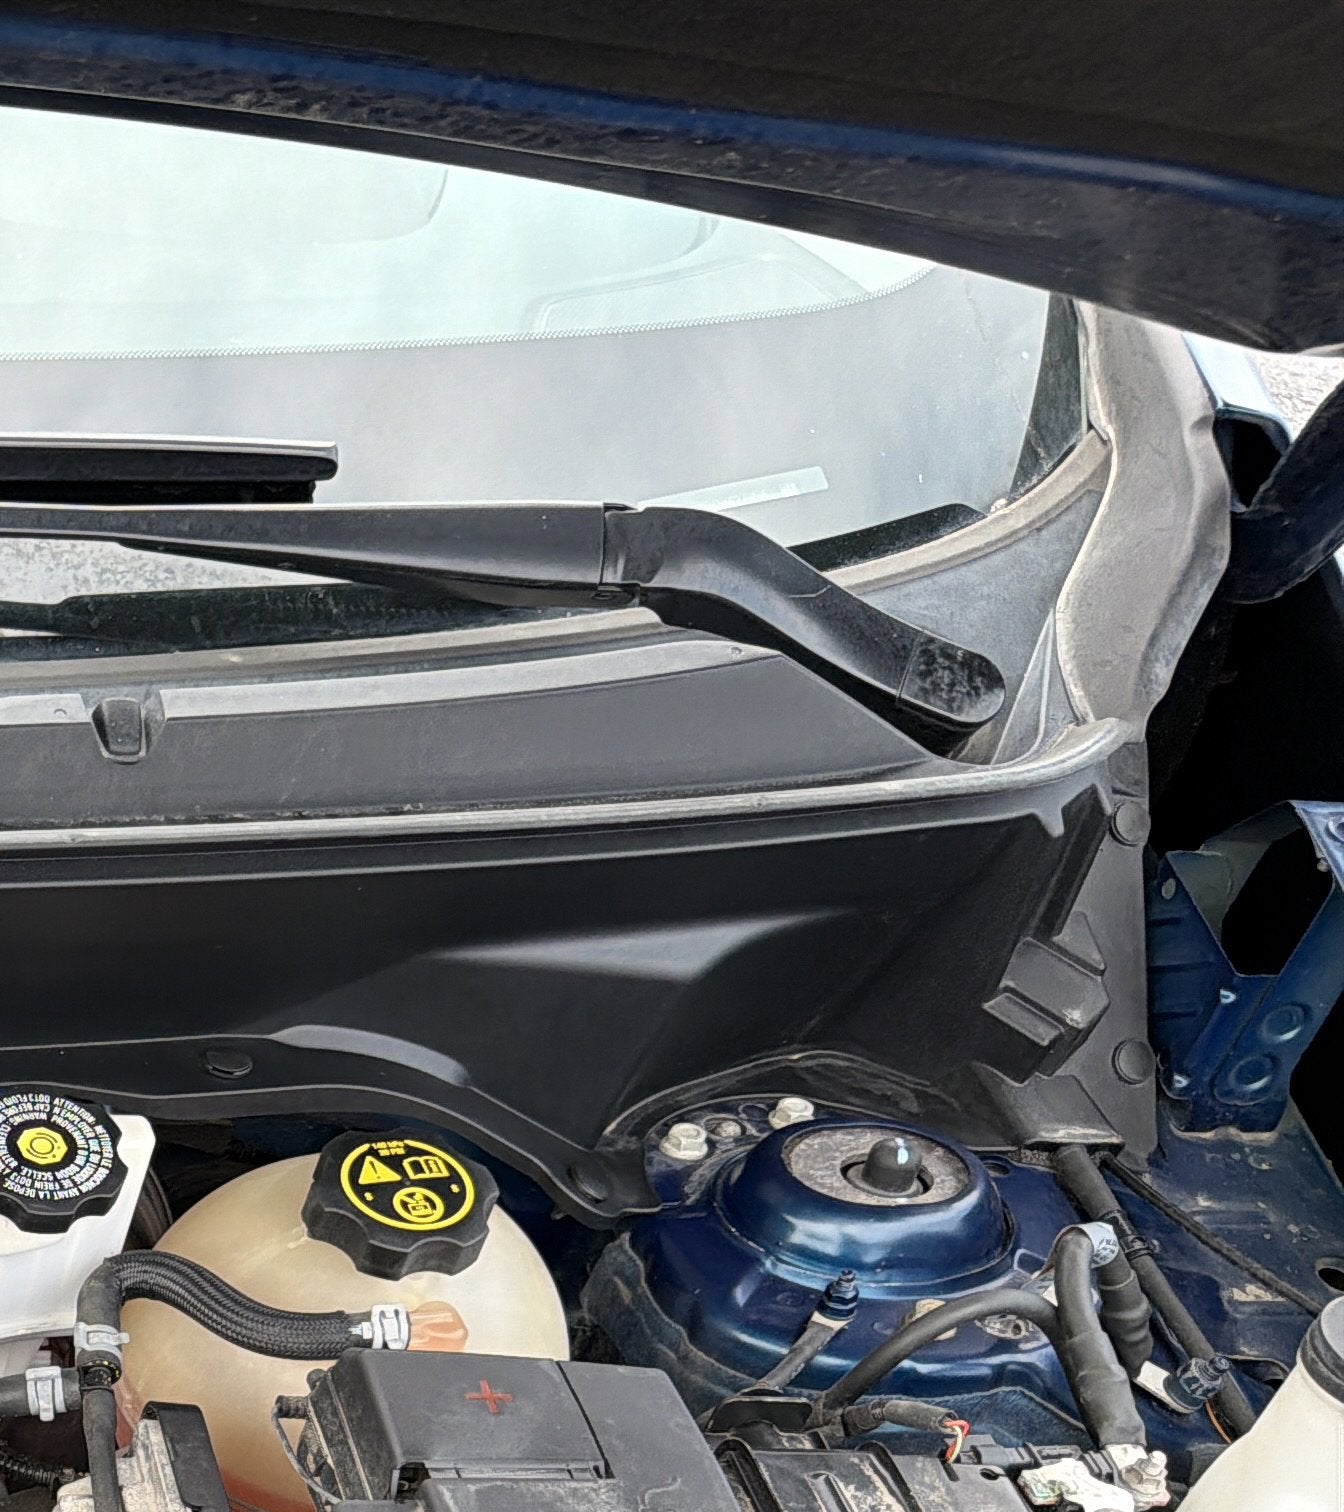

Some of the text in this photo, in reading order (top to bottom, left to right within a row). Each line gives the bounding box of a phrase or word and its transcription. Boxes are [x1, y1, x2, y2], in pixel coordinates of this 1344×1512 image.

[3, 1094, 28, 1106] FLUID
[1, 1102, 33, 1116] BEFORE
[34, 1103, 50, 1111] CAP
[34, 1181, 60, 1190] FREIN
[38, 1191, 50, 1199] LA
[53, 1188, 80, 1200] AVANT
